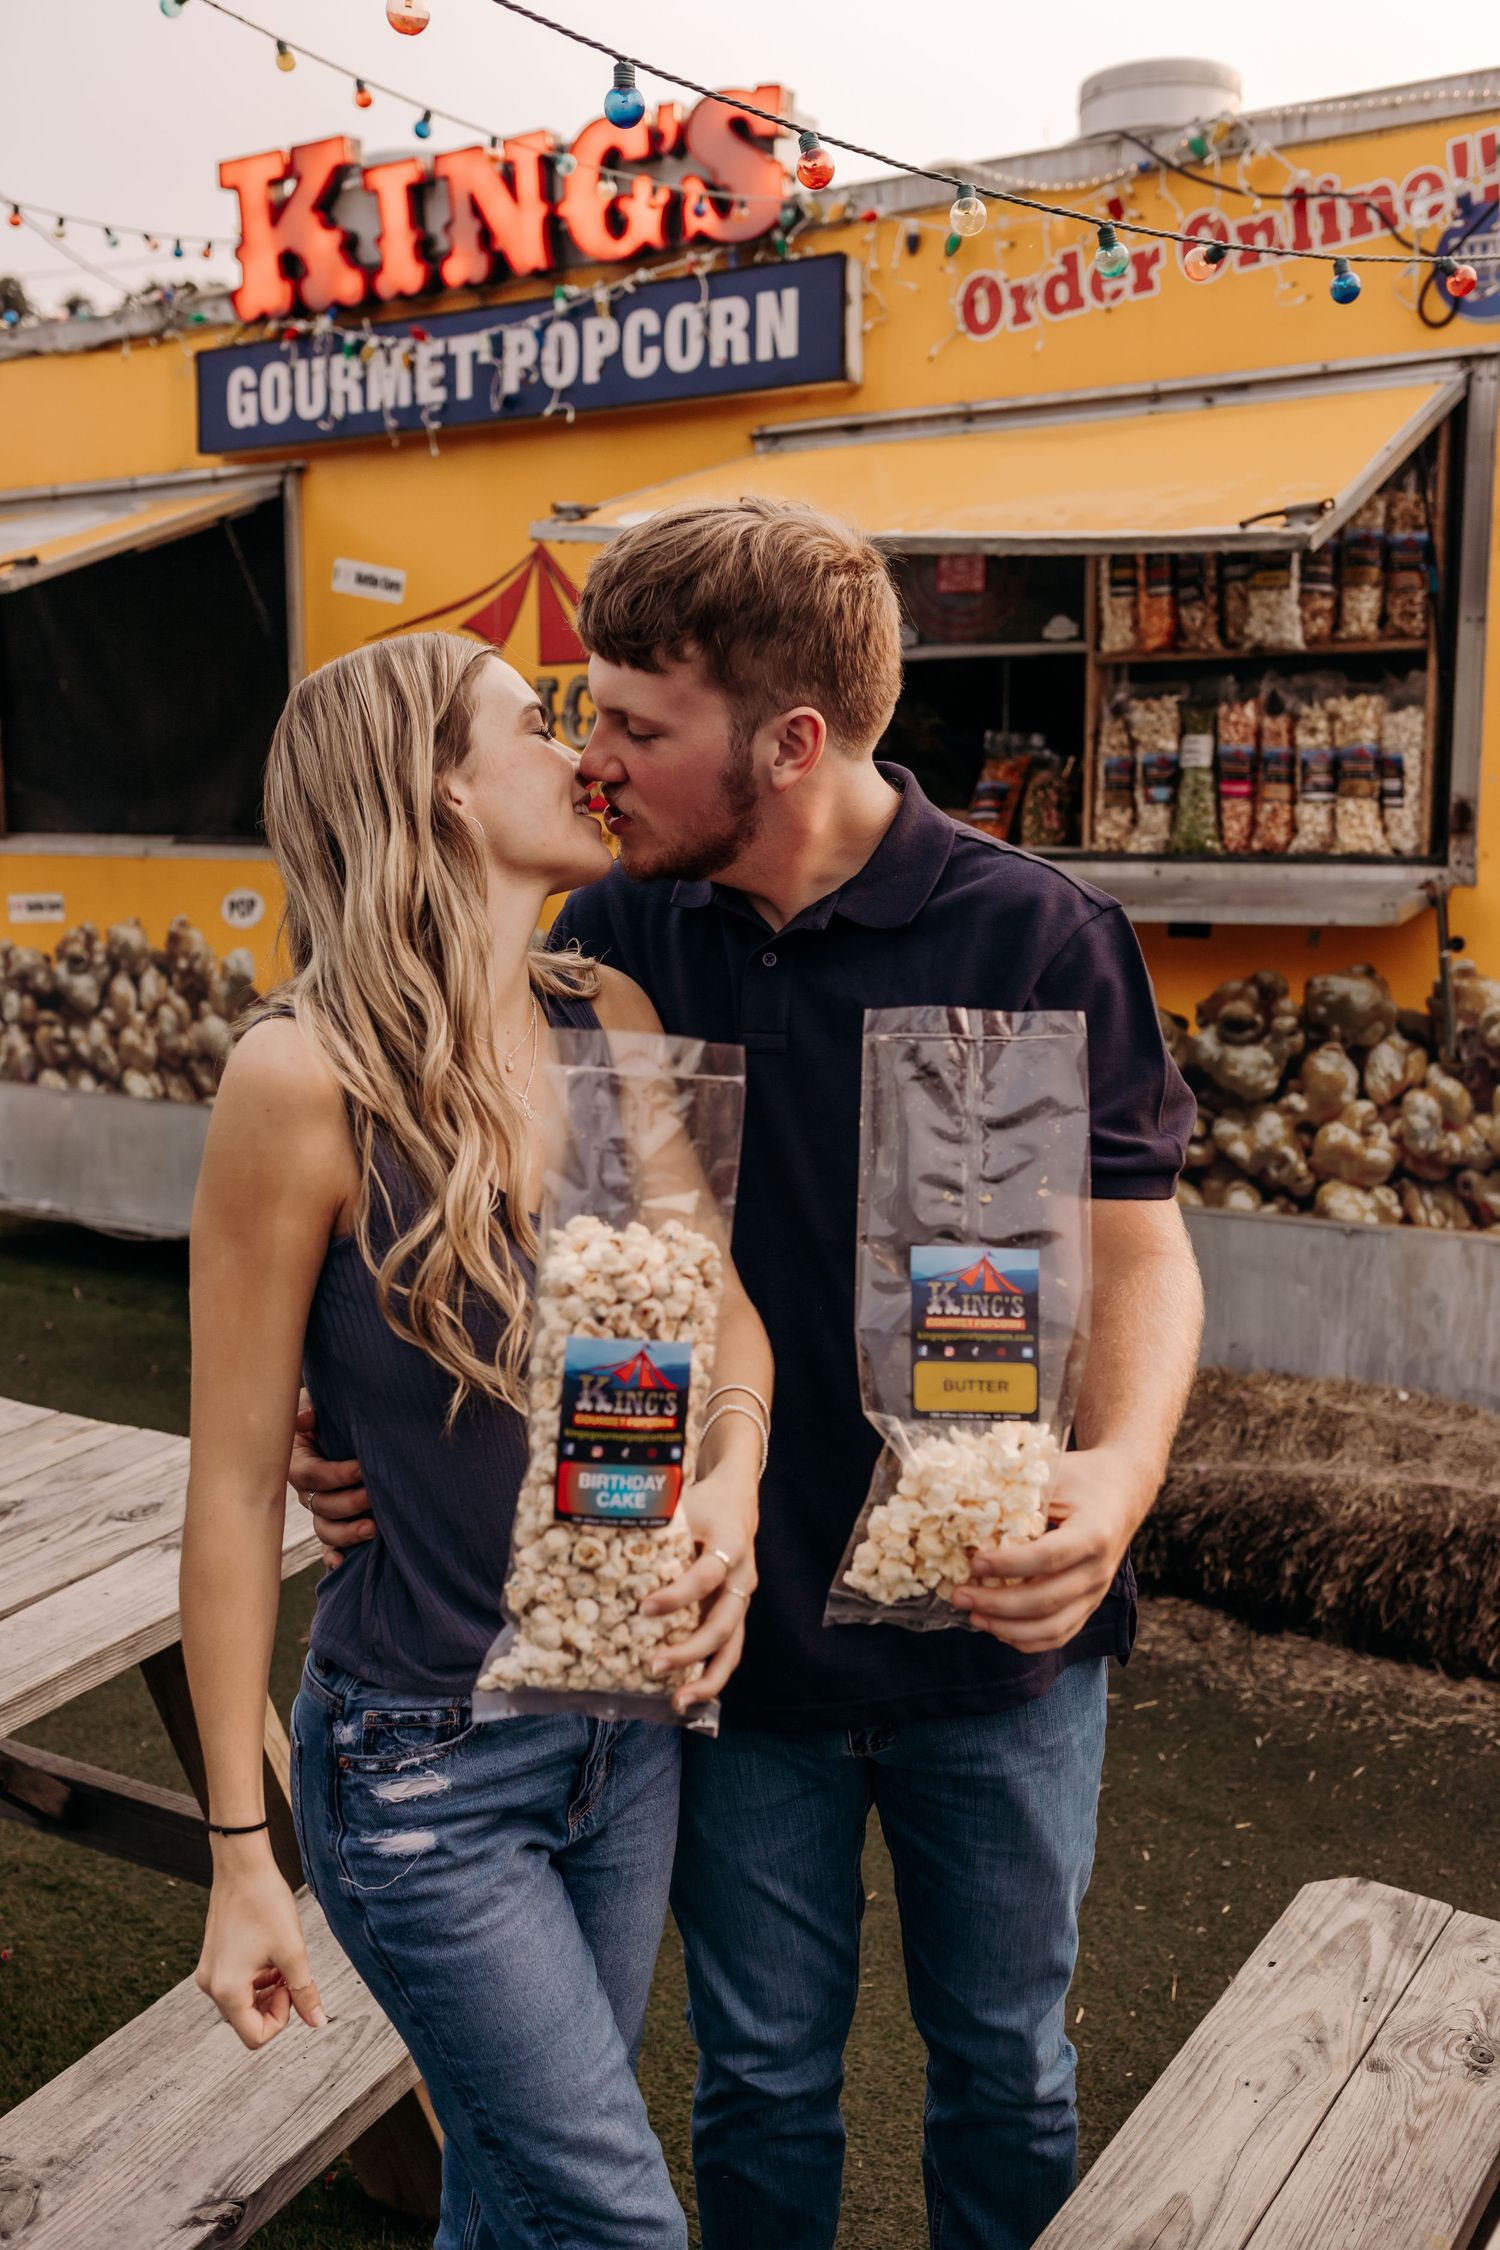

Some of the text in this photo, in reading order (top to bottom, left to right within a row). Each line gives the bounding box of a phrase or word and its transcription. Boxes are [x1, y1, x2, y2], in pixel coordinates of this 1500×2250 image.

[219, 85, 788, 323] KING'S
[959, 243, 1163, 341] Order
[226, 286, 799, 430] GOURMET POPCORN
[943, 1379, 1009, 1393] BUTTER
[577, 1472, 667, 1492] BIRTHDAY
[595, 1491, 647, 1509] CAKE
